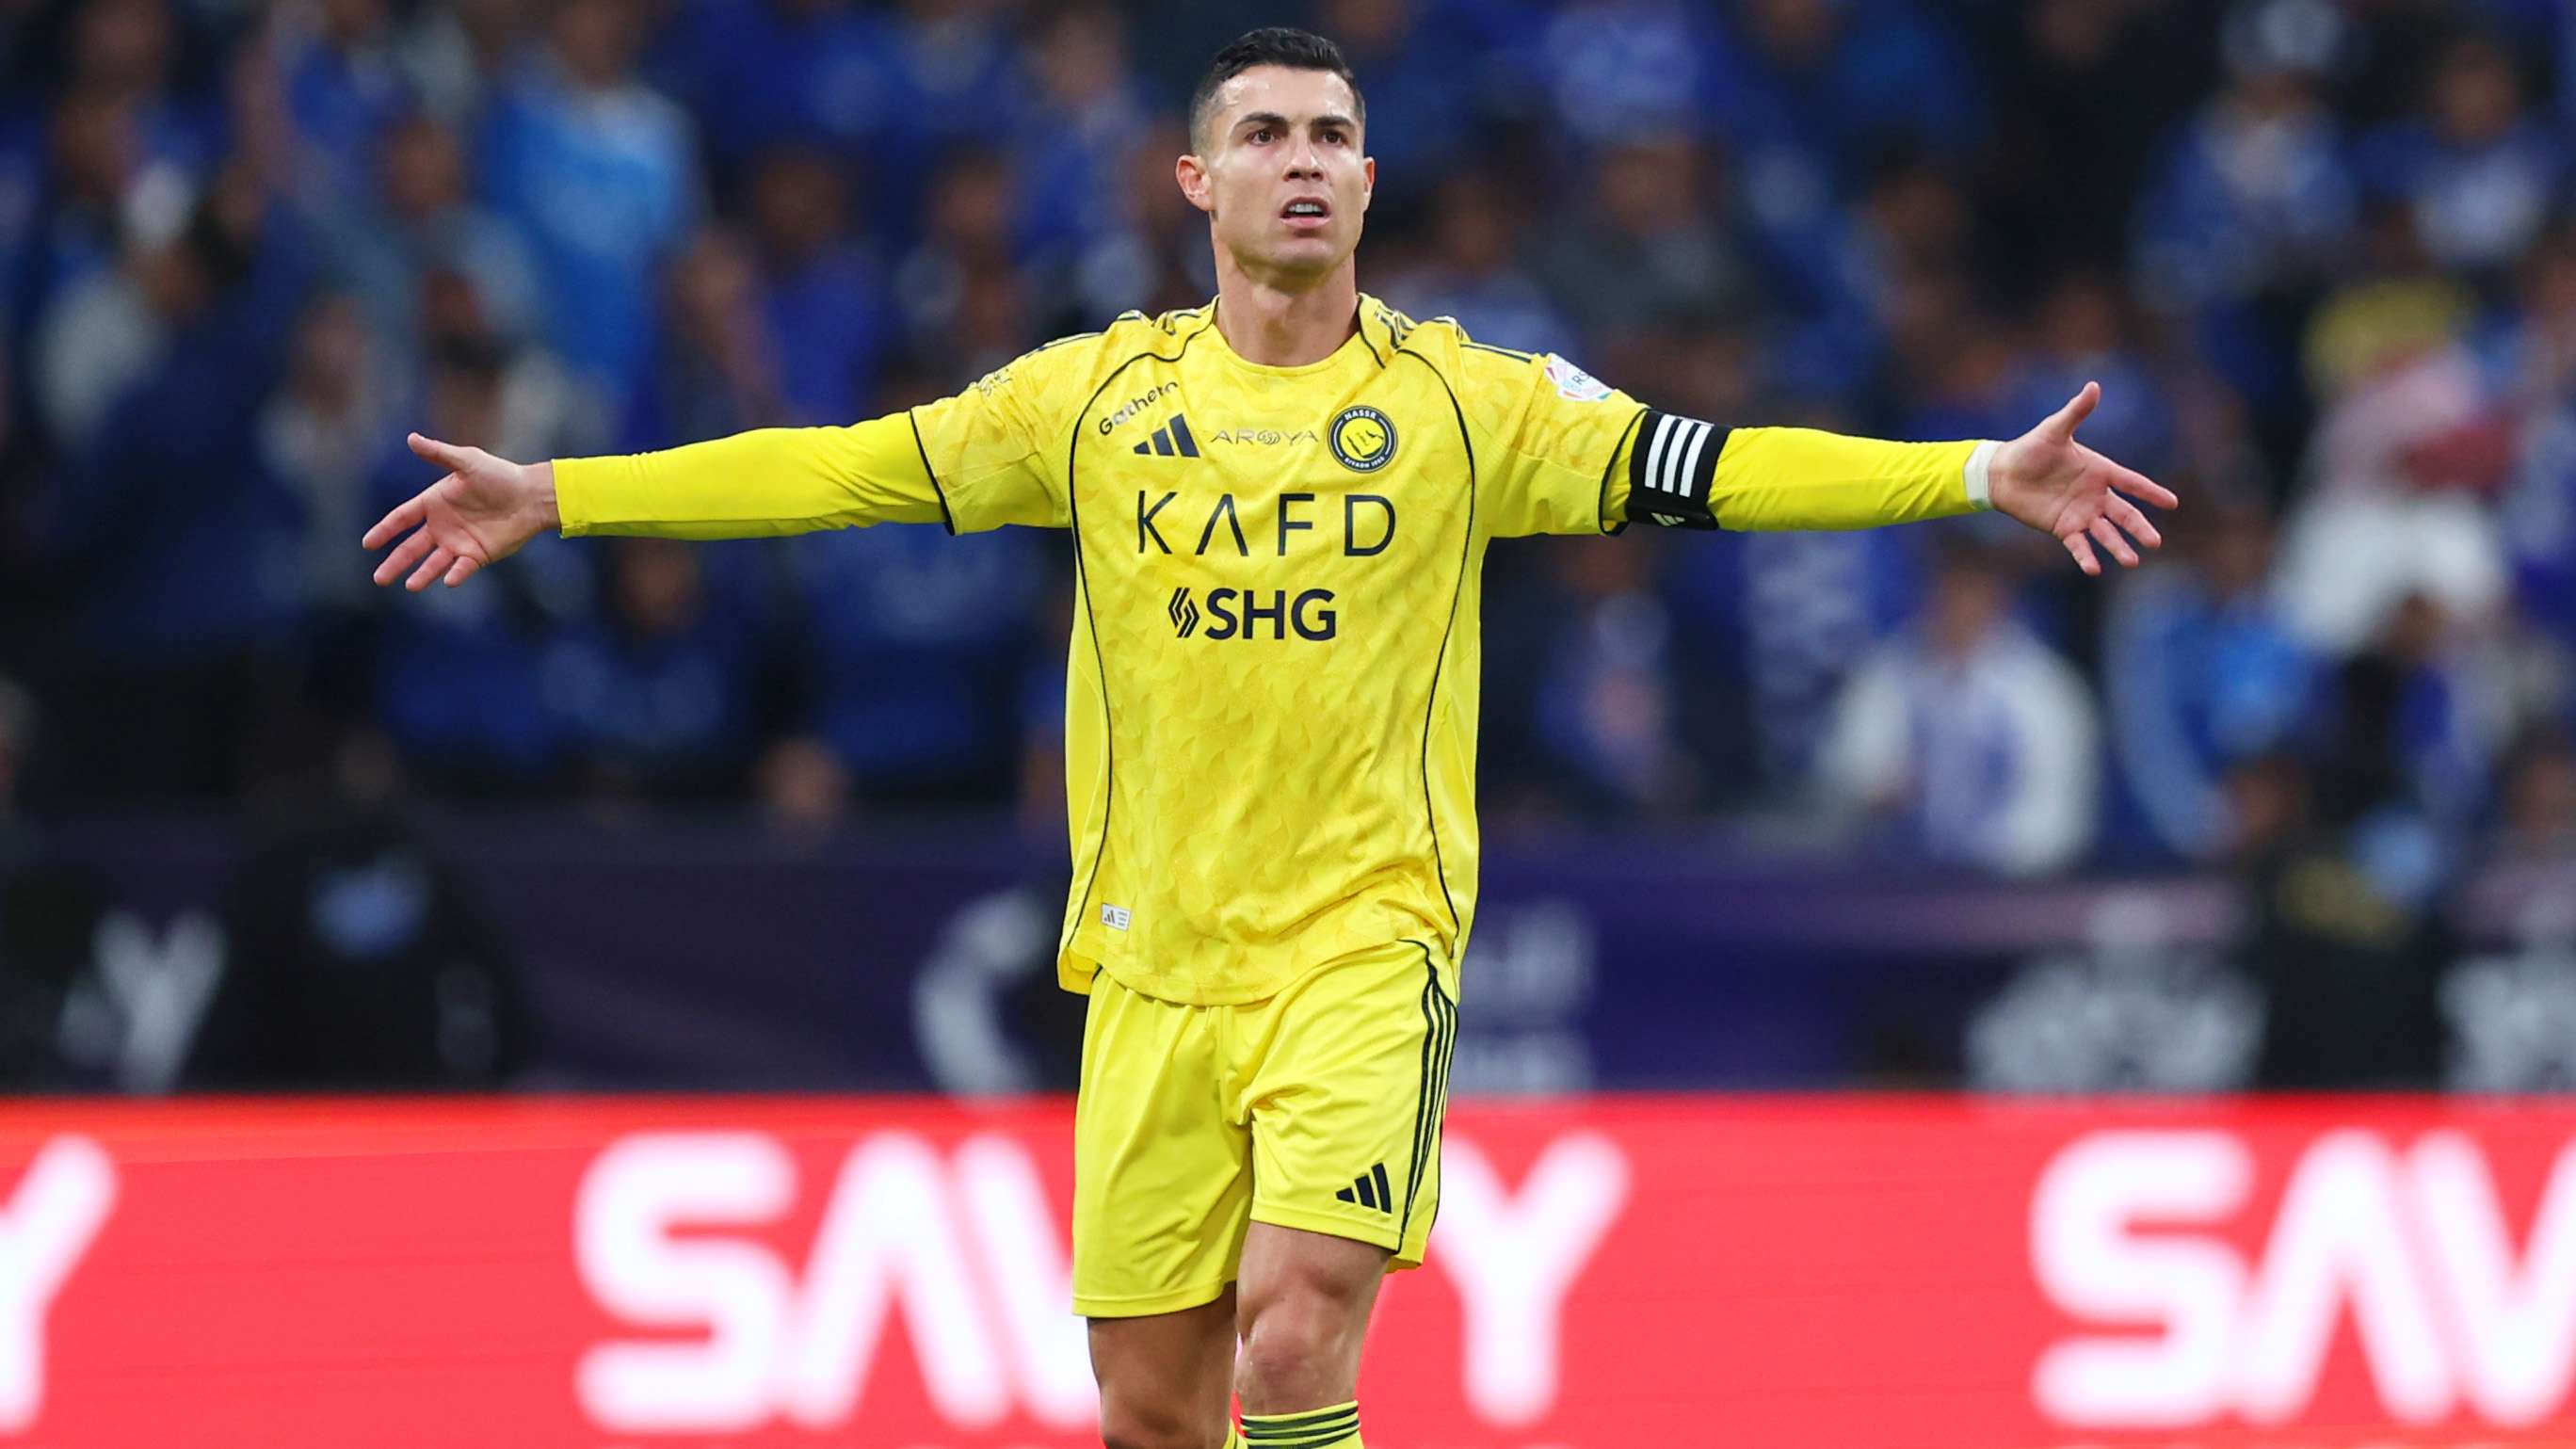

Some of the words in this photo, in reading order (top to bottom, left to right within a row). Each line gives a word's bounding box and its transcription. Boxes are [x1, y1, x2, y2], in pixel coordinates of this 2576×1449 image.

[1344, 409, 1377, 421] NASSR
[1137, 491, 1395, 557] KAFD
[1204, 588, 1336, 641] SHG
